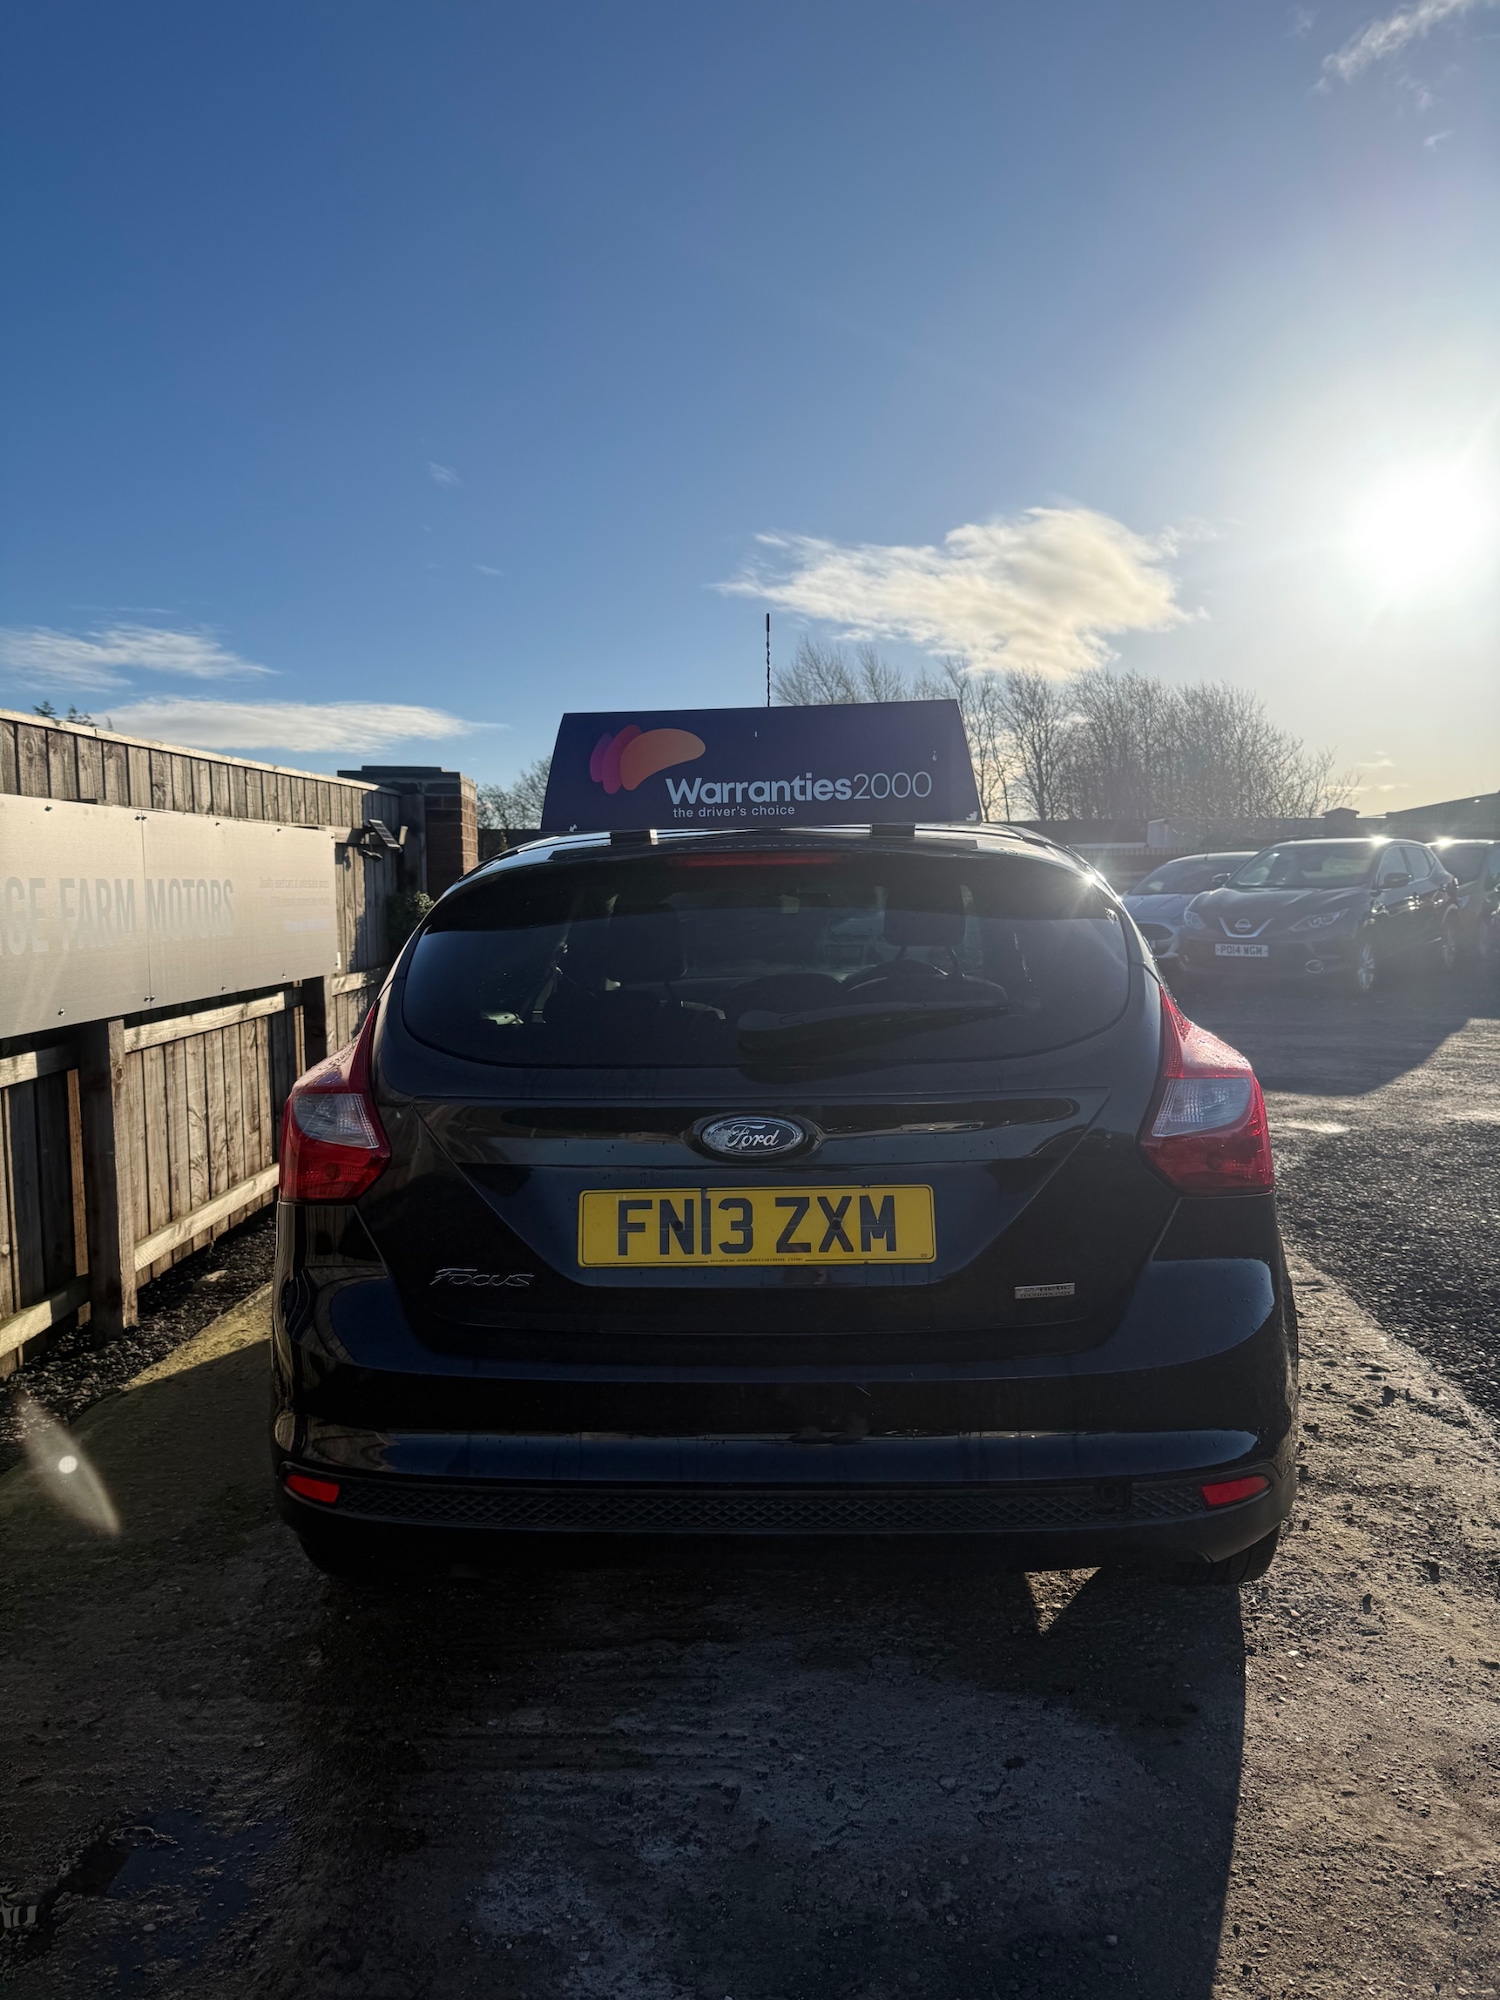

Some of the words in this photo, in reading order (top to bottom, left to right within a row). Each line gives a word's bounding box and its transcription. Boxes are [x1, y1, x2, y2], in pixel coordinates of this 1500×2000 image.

[665, 771, 932, 805] Warranties2000
[673, 807, 693, 818] the
[698, 805, 747, 818] driver's
[751, 804, 795, 816] choice
[0, 876, 49, 956] GE
[59, 877, 136, 949] FARM
[146, 878, 234, 940] MOTORS
[728, 1124, 780, 1148] Ford
[617, 1197, 754, 1256] FN13
[774, 1194, 898, 1254] ZXM
